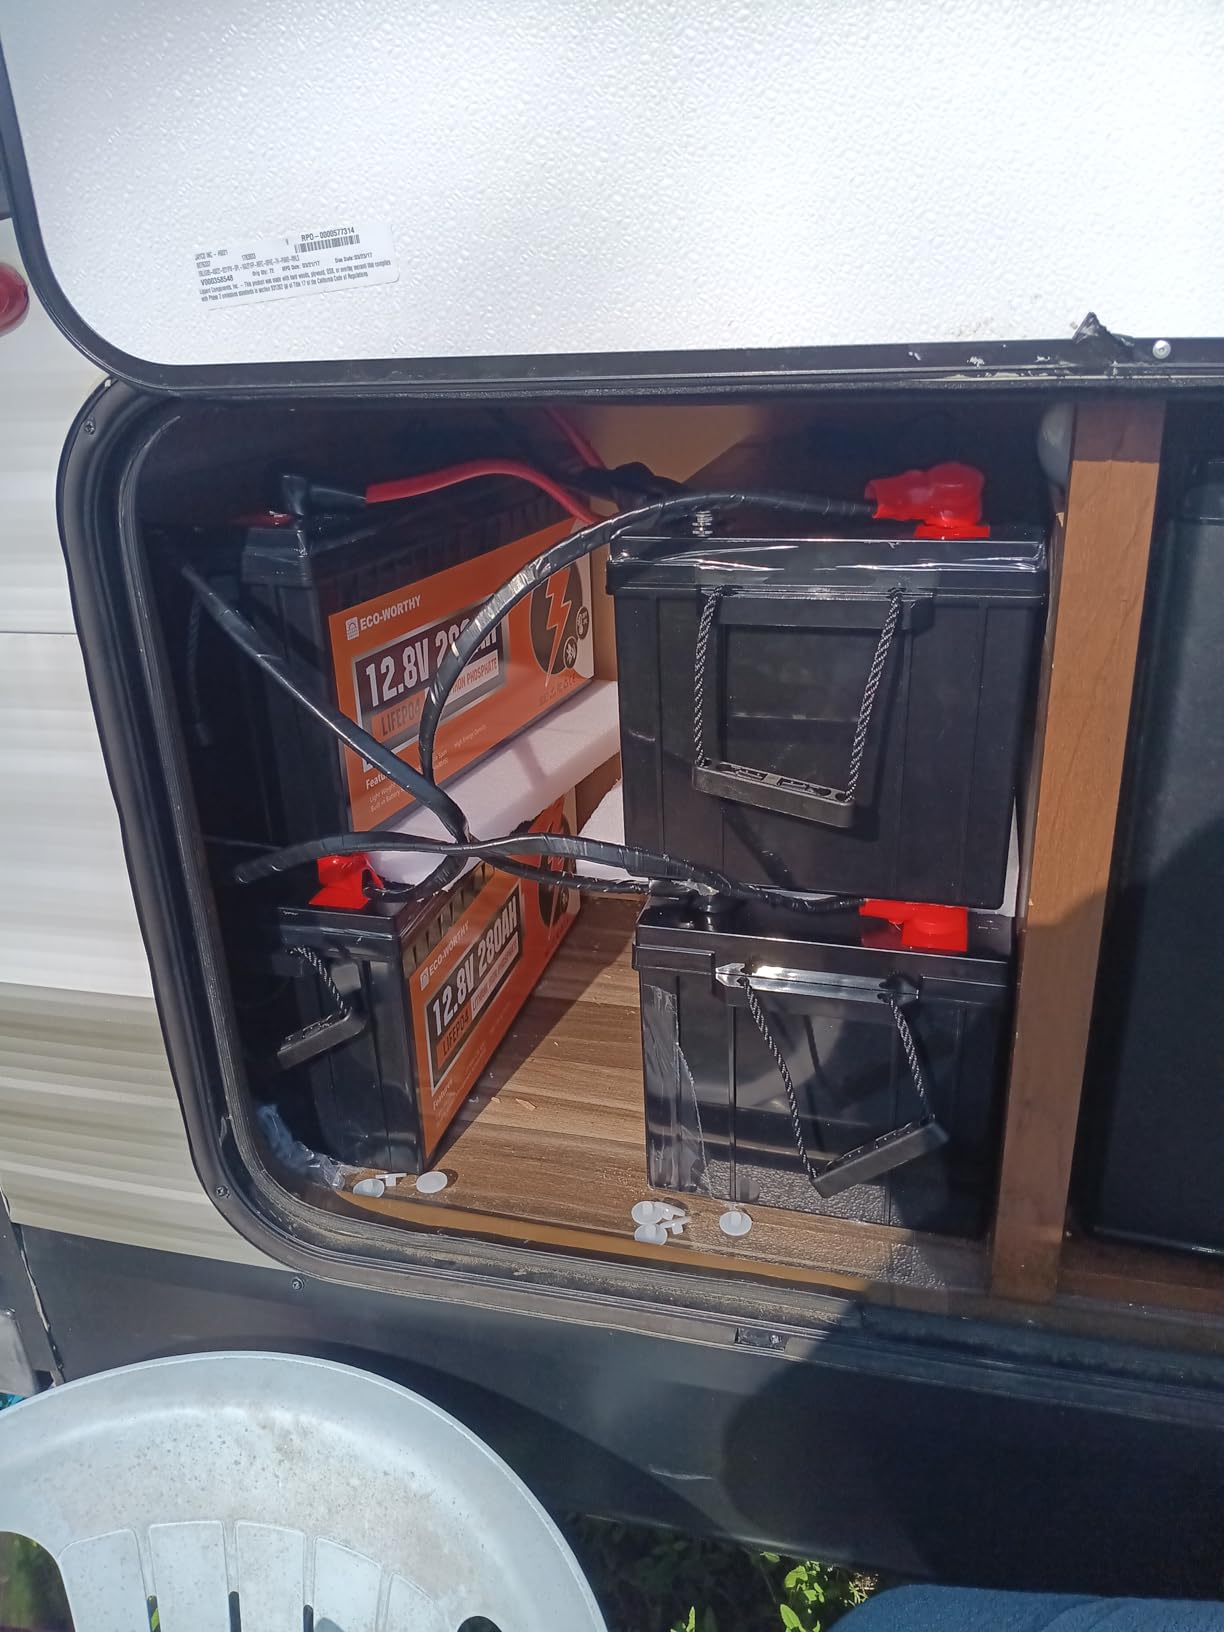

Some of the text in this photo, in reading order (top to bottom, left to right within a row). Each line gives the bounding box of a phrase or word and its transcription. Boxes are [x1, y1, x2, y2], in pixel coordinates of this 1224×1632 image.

[360, 595, 421, 631] ECO-WORTHY
[366, 638, 430, 708] 12.8V
[466, 658, 498, 688] PHOSPHATE
[366, 772, 388, 790] Featu
[429, 920, 470, 977] ECO-WORTHY
[432, 953, 475, 1037] 12.8V
[477, 895, 517, 978] 280AH
